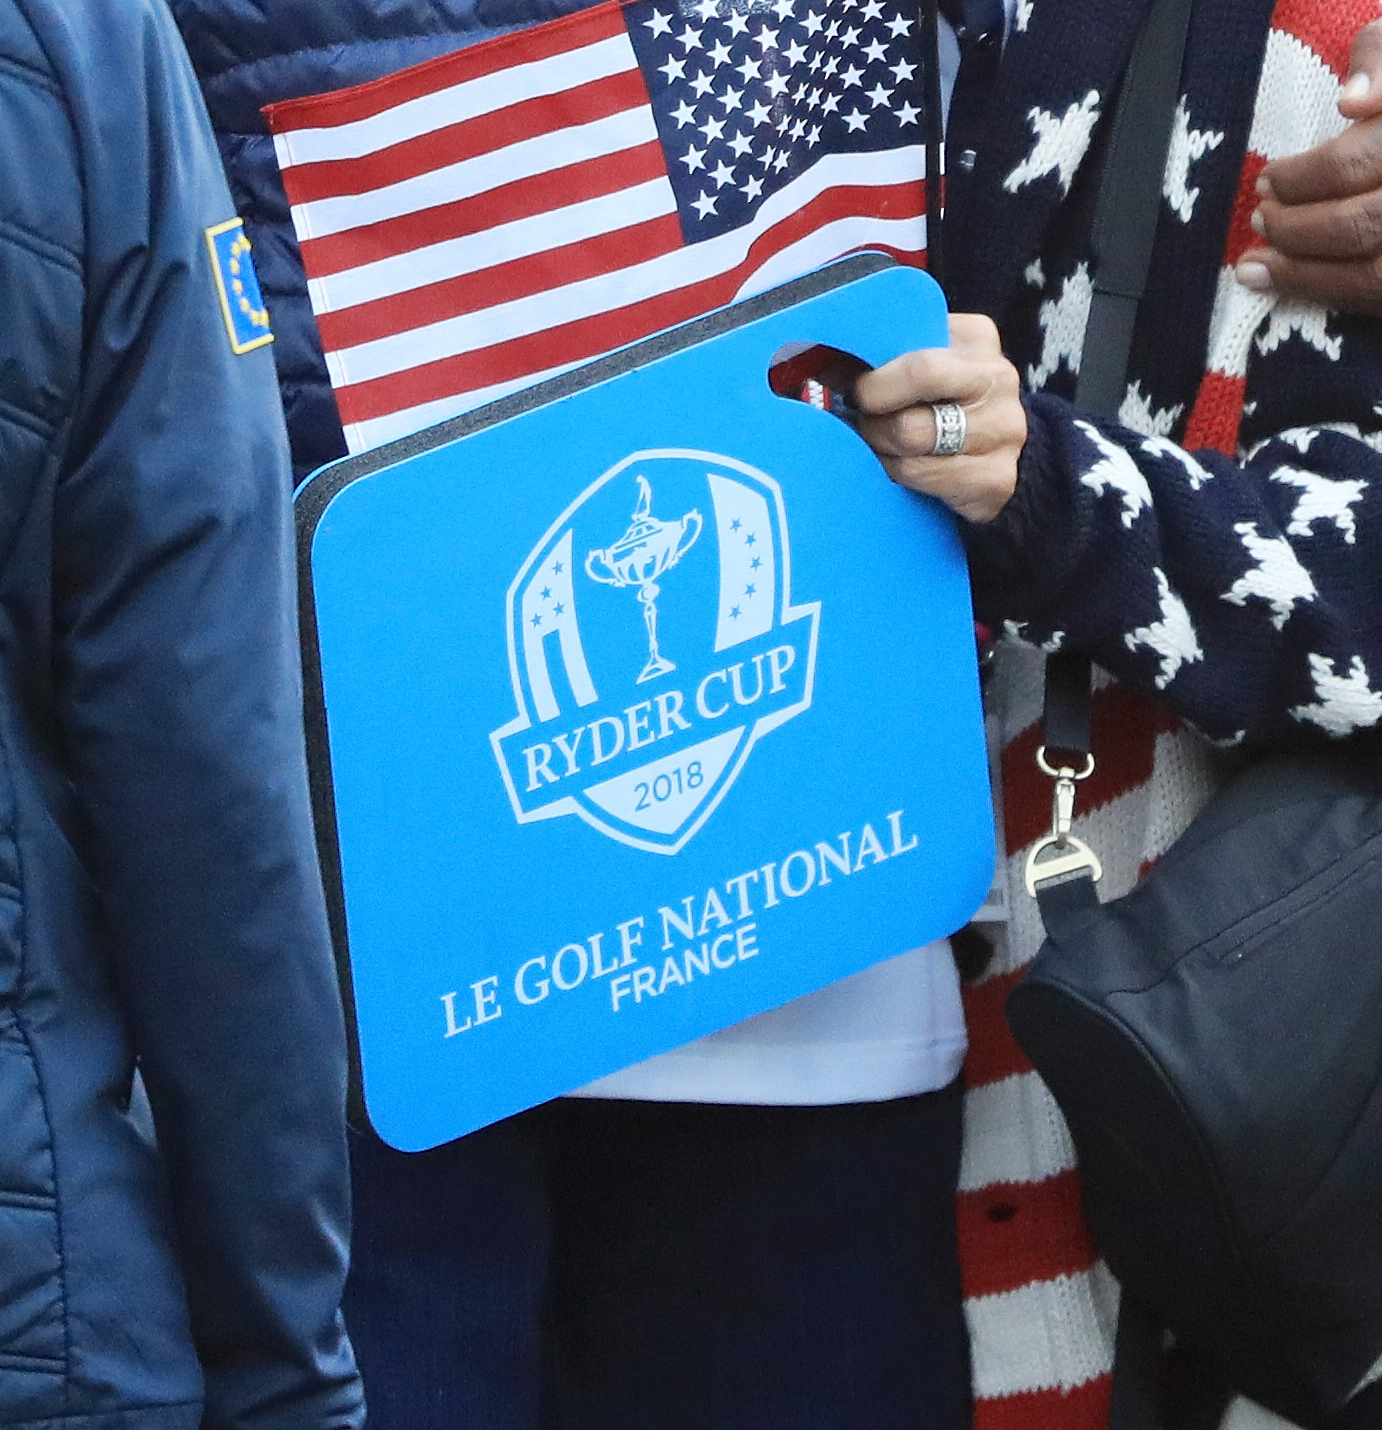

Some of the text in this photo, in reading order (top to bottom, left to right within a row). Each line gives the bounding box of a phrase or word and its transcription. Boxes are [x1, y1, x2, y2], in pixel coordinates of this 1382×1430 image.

[522, 644, 797, 793] RYDER CUP
[633, 761, 704, 813] 2018
[440, 809, 918, 1038] LE GOLF NATIONAL
[610, 923, 760, 1012] FRANCE
